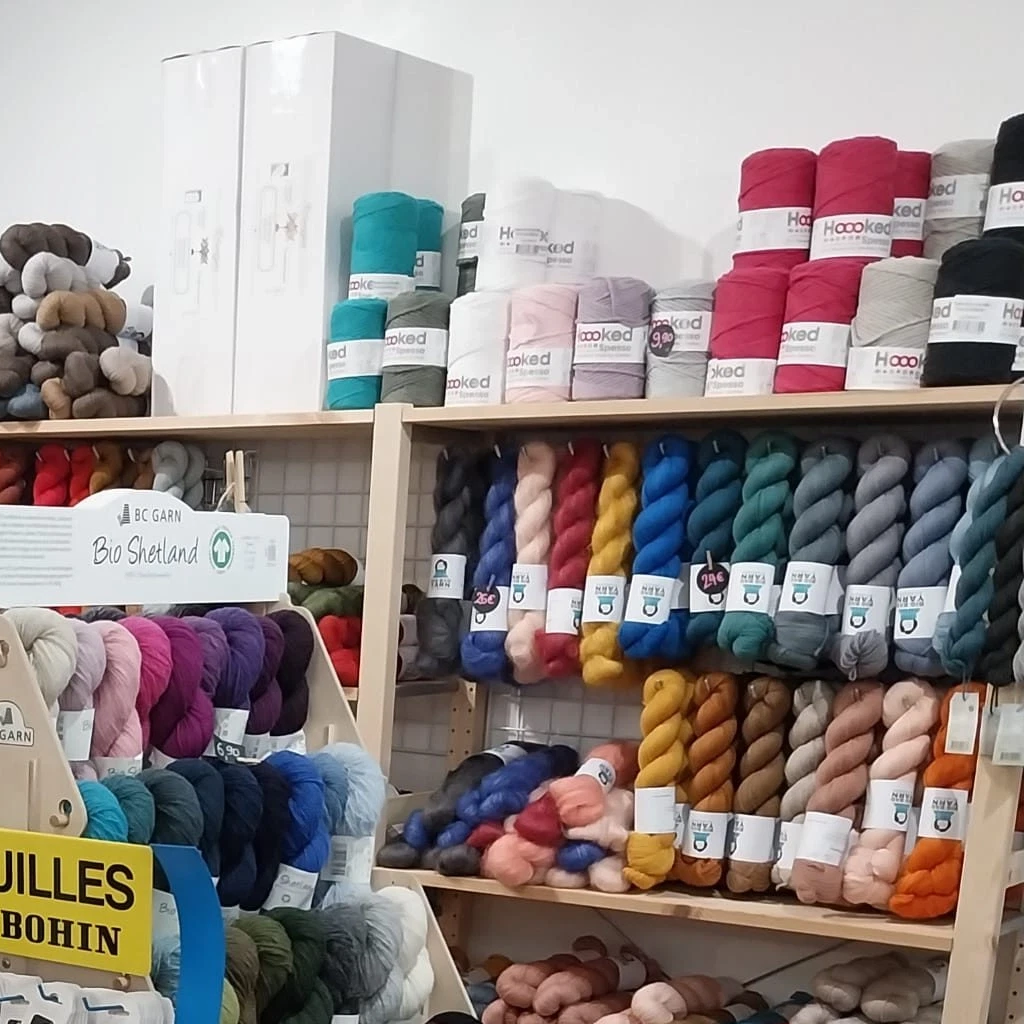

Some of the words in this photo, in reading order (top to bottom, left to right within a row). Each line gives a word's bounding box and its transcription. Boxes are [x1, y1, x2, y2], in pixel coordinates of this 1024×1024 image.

[579, 327, 633, 342] oooked
[134, 508, 149, 523] BC
[152, 508, 182, 523] GARN
[92, 536, 122, 565] Bio
[127, 535, 199, 565] Shetland
[216, 742, 241, 761] 6,90
[0, 910, 121, 956] BOHIN
